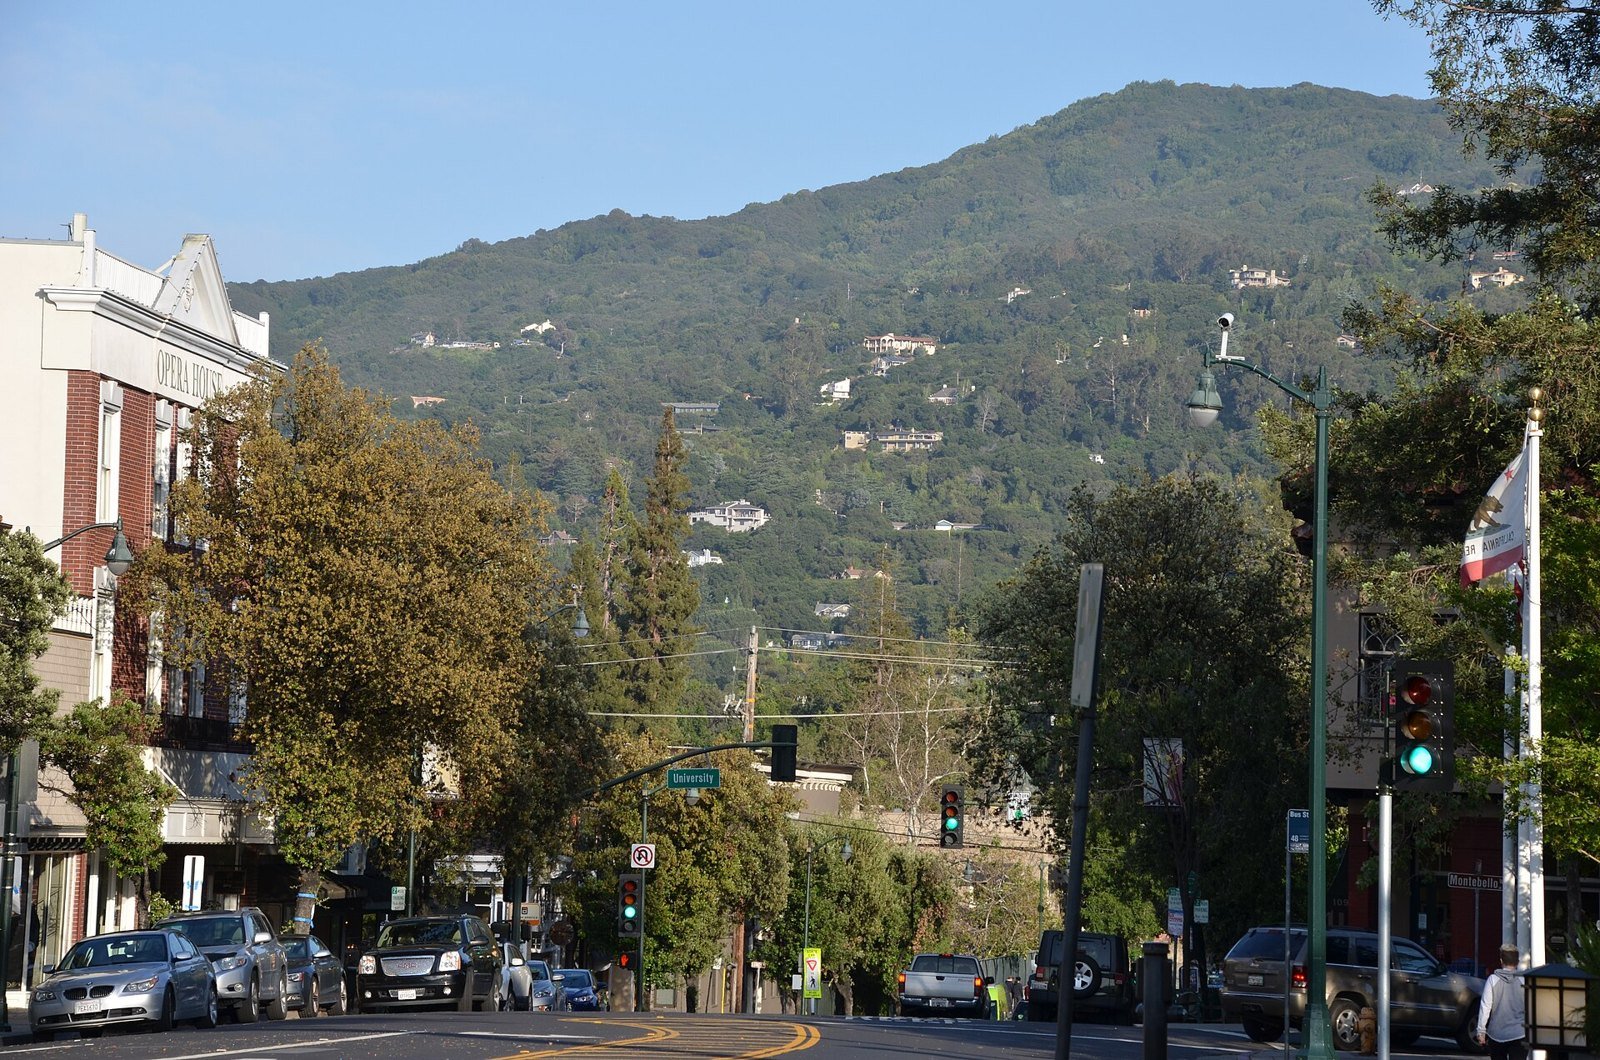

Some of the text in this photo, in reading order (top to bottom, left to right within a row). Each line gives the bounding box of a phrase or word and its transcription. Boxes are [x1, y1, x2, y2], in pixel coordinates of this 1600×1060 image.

[157, 349, 223, 400] OPERA HOUSE
[673, 772, 714, 784] University
[1291, 834, 1299, 842] 48
[1450, 874, 1499, 889] Montebello
